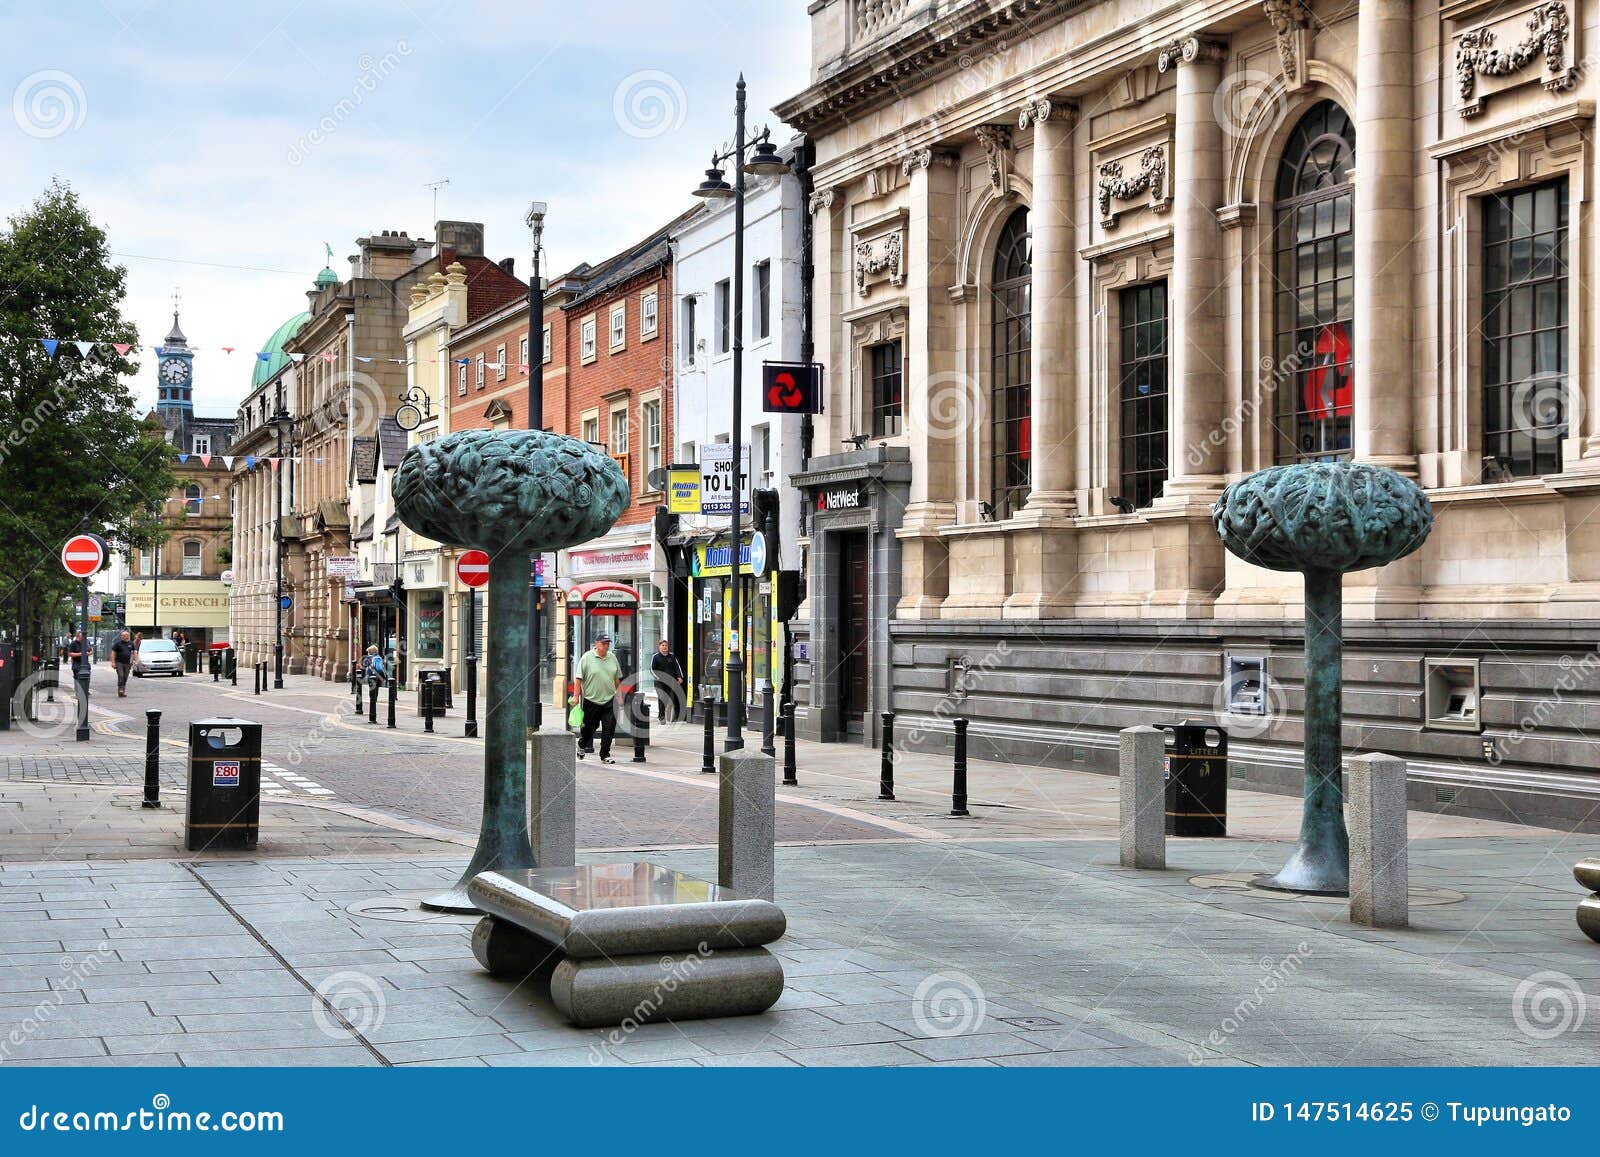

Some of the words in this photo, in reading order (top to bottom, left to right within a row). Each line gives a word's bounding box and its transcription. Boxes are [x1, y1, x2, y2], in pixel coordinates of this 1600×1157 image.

[714, 461, 733, 472] SHO
[672, 482, 699, 490] Mobile
[703, 474, 720, 492] TO
[724, 473, 748, 491] LT
[675, 490, 691, 498] Hub
[826, 489, 859, 509] NatWest
[704, 545, 733, 568] Mobil
[173, 597, 219, 607] FRENCH
[1190, 747, 1218, 755] LITTER
[215, 766, 239, 777] £80
